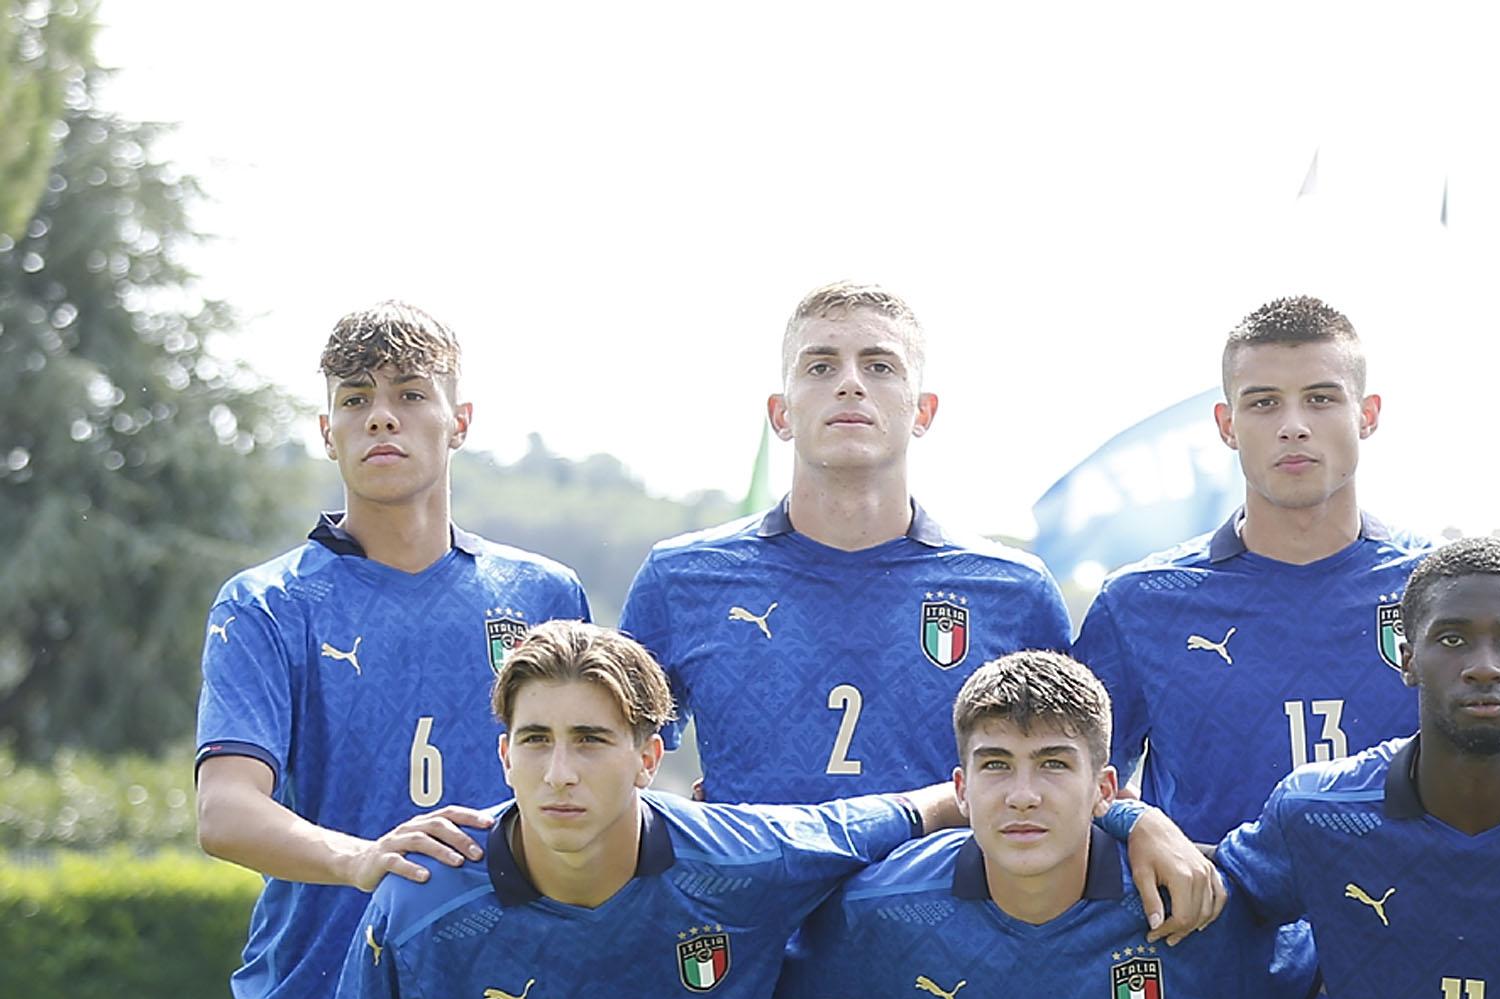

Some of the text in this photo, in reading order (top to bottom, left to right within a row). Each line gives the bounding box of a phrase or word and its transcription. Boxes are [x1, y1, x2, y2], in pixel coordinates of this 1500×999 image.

[926, 606, 964, 621] ITALIA
[826, 684, 863, 776] 2
[1284, 699, 1348, 768] 13
[410, 717, 443, 807] 6
[682, 937, 724, 954] ITALIA
[1116, 962, 1157, 977] ITALIA
